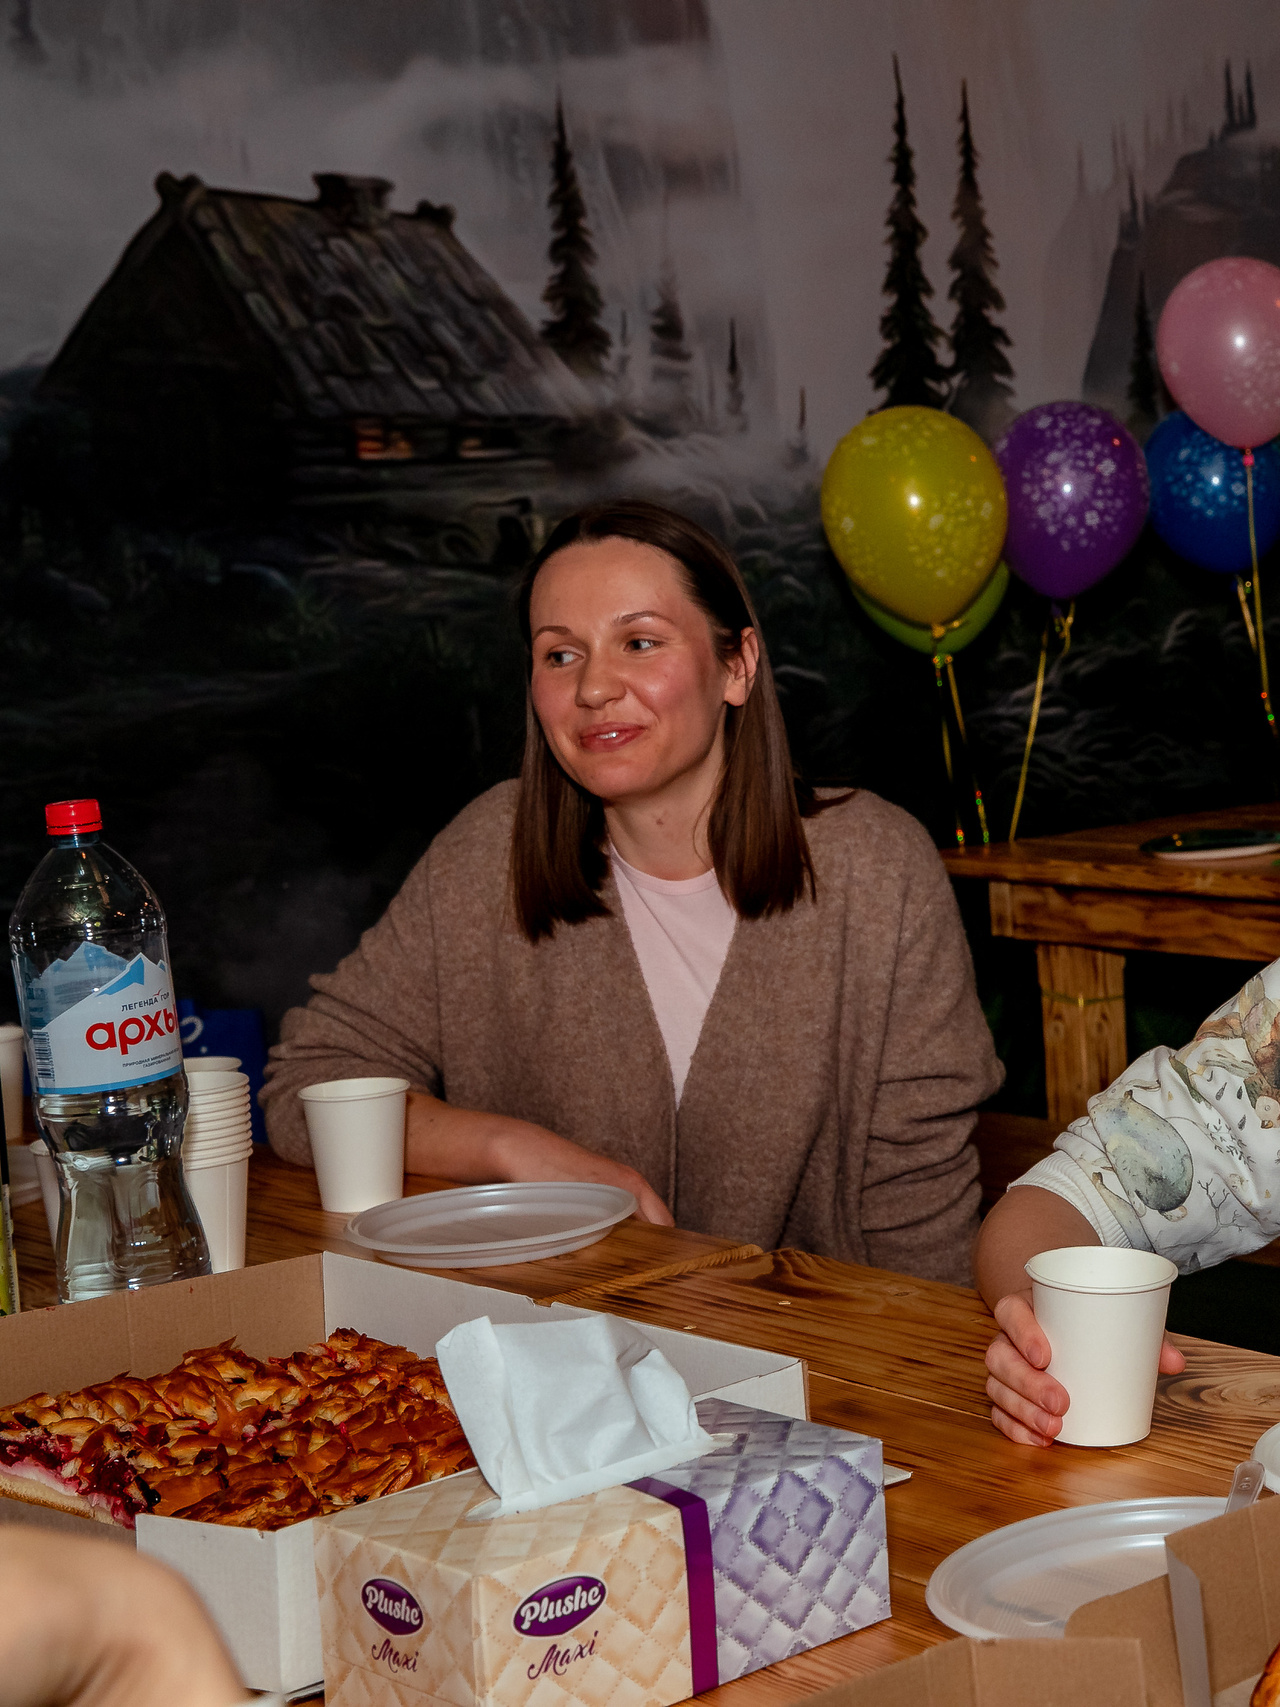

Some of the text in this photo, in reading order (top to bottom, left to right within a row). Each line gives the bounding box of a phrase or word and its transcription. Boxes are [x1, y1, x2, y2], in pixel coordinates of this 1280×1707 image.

[121, 991, 170, 1012] ЛЕГЕНДА ГОР
[85, 1003, 179, 1056] архы
[365, 1585, 421, 1626] Plushe
[520, 1584, 602, 1631] Plushe
[371, 1638, 419, 1674] Maxi
[527, 1630, 599, 1680] Maxi
